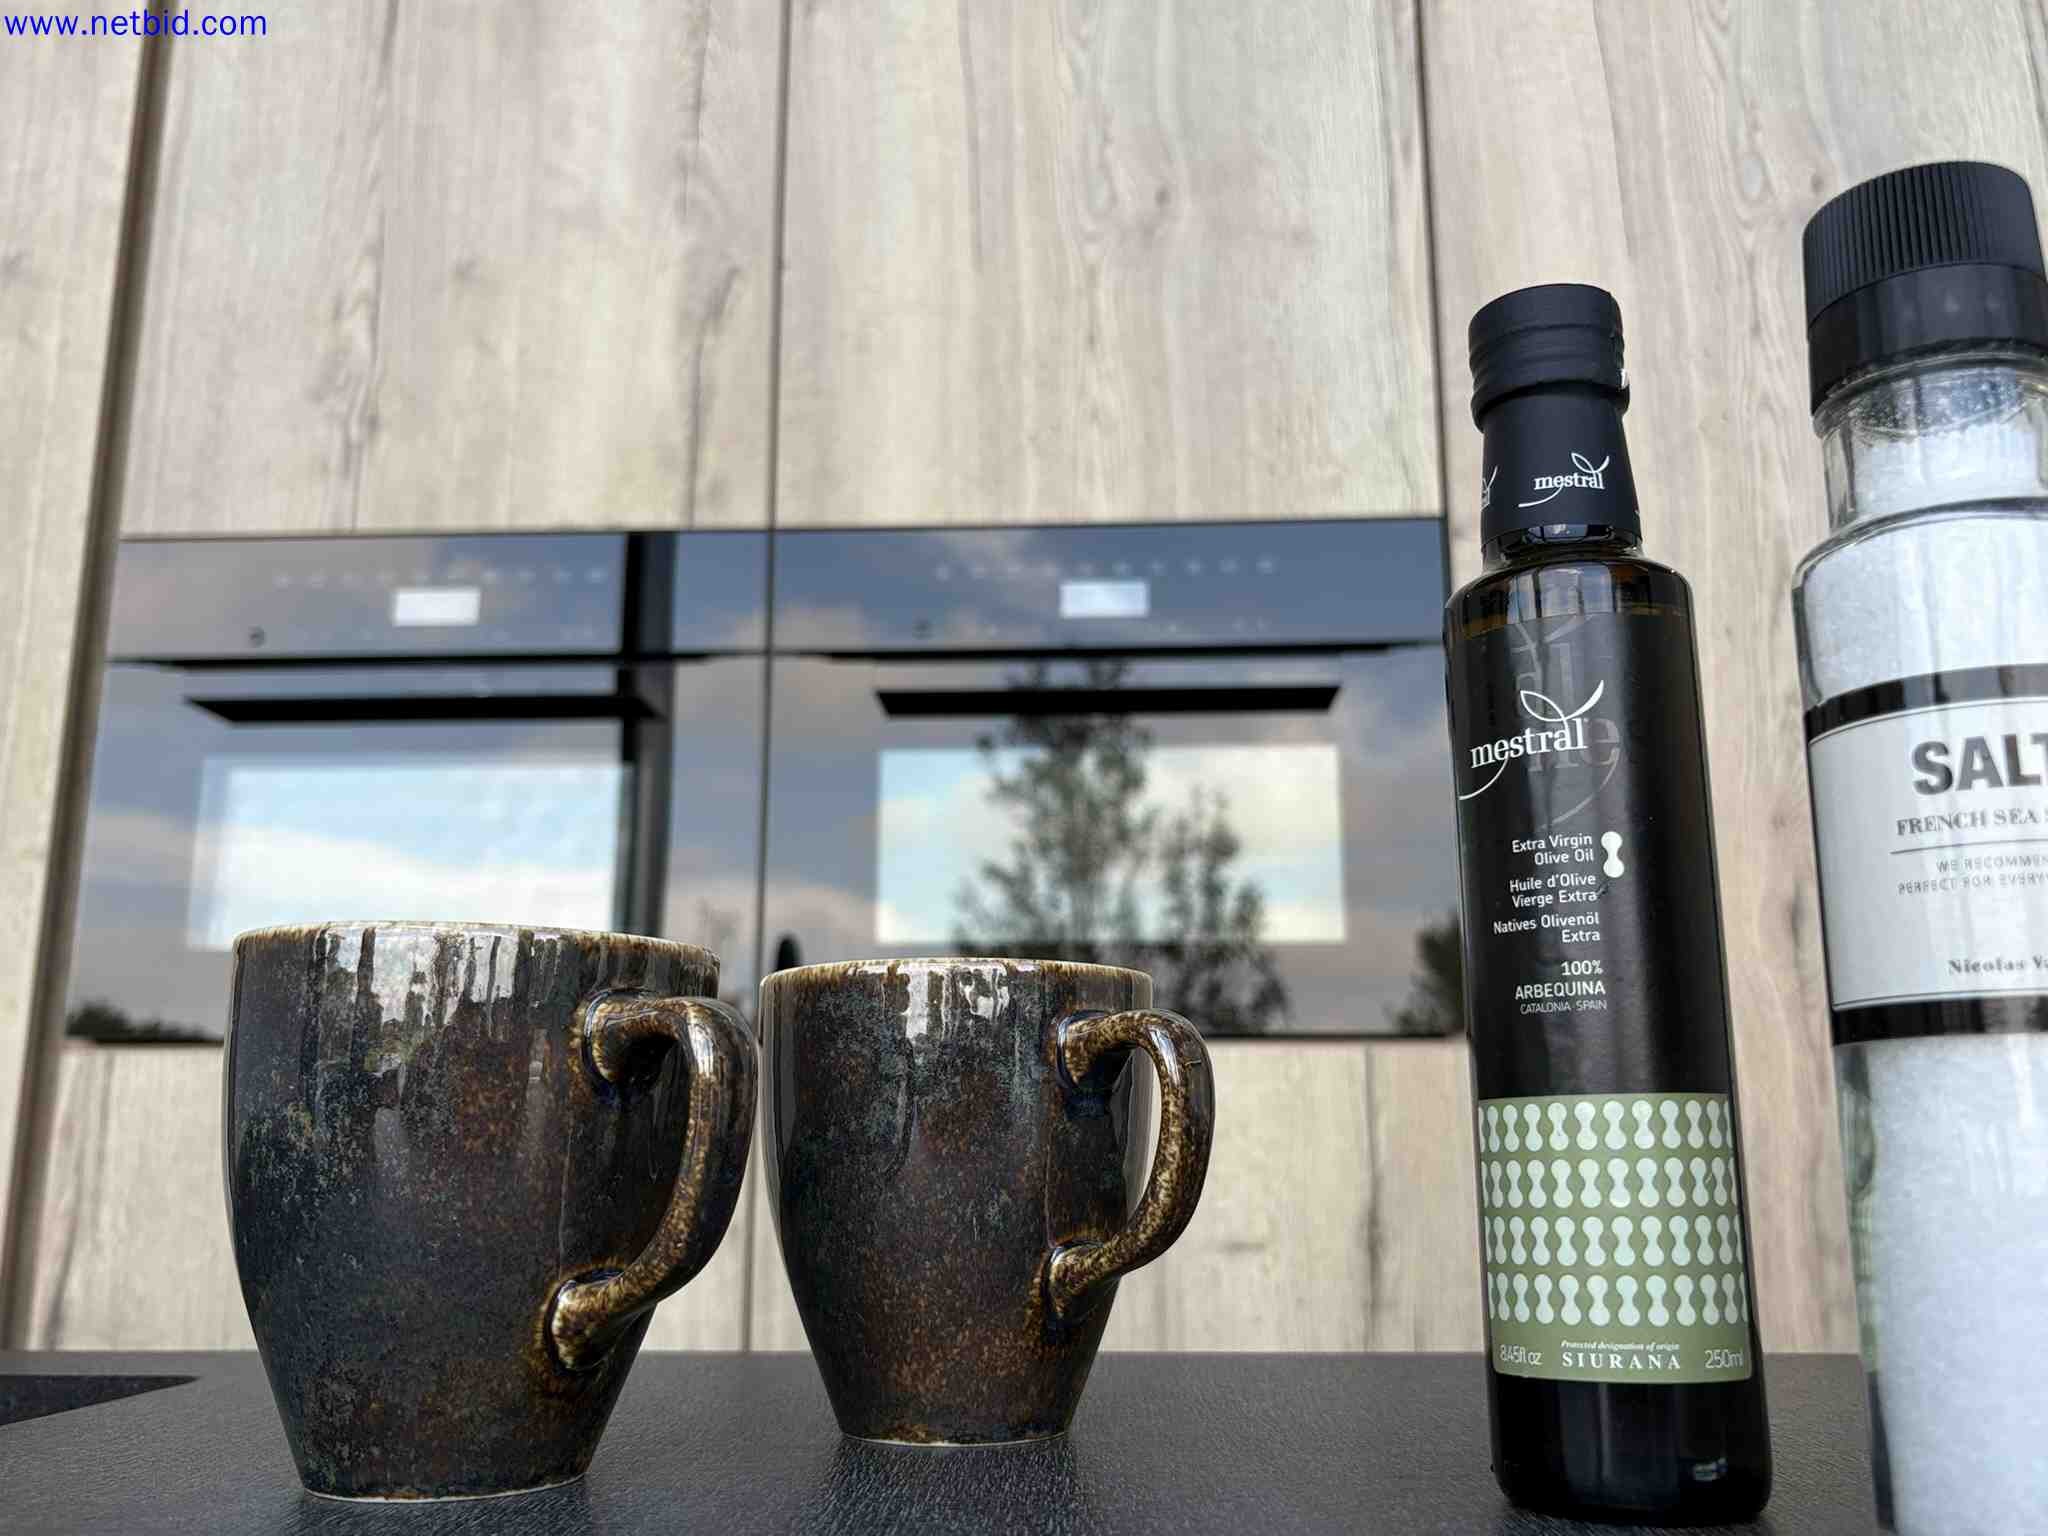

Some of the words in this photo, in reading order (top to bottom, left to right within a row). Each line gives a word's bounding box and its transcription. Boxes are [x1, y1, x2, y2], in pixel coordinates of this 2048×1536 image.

[1533, 468, 1605, 490] mestral
[1469, 718, 1588, 769] mestral
[1896, 811, 1986, 836] FRENCH
[1993, 808, 2037, 825] SEA
[1512, 839, 1546, 853] Extra
[1549, 833, 1593, 850] Virgin
[1534, 851, 1569, 865] Olive
[1574, 849, 1594, 862] Oil
[1936, 859, 1958, 873] WE
[1509, 878, 1542, 893] Huile
[1547, 873, 1596, 888] d'Olive
[1897, 878, 1957, 895] PERFECT
[1962, 874, 1992, 889] FOR
[1512, 893, 1553, 908] Vierge
[1559, 890, 1598, 903] Extra
[1493, 918, 1537, 934] Natives
[1541, 912, 1600, 928] Olivenöl
[1562, 930, 1600, 943] Extra
[1561, 960, 1604, 976] 100%
[1949, 956, 2024, 975] Nicolas
[1515, 981, 1606, 1000] ARBEQUINA
[1520, 1001, 1571, 1015] CATALONIA
[1575, 999, 1608, 1011] SPAIN
[1562, 1352, 1681, 1369] SIURANA
[1704, 1347, 1743, 1369] 250ml
